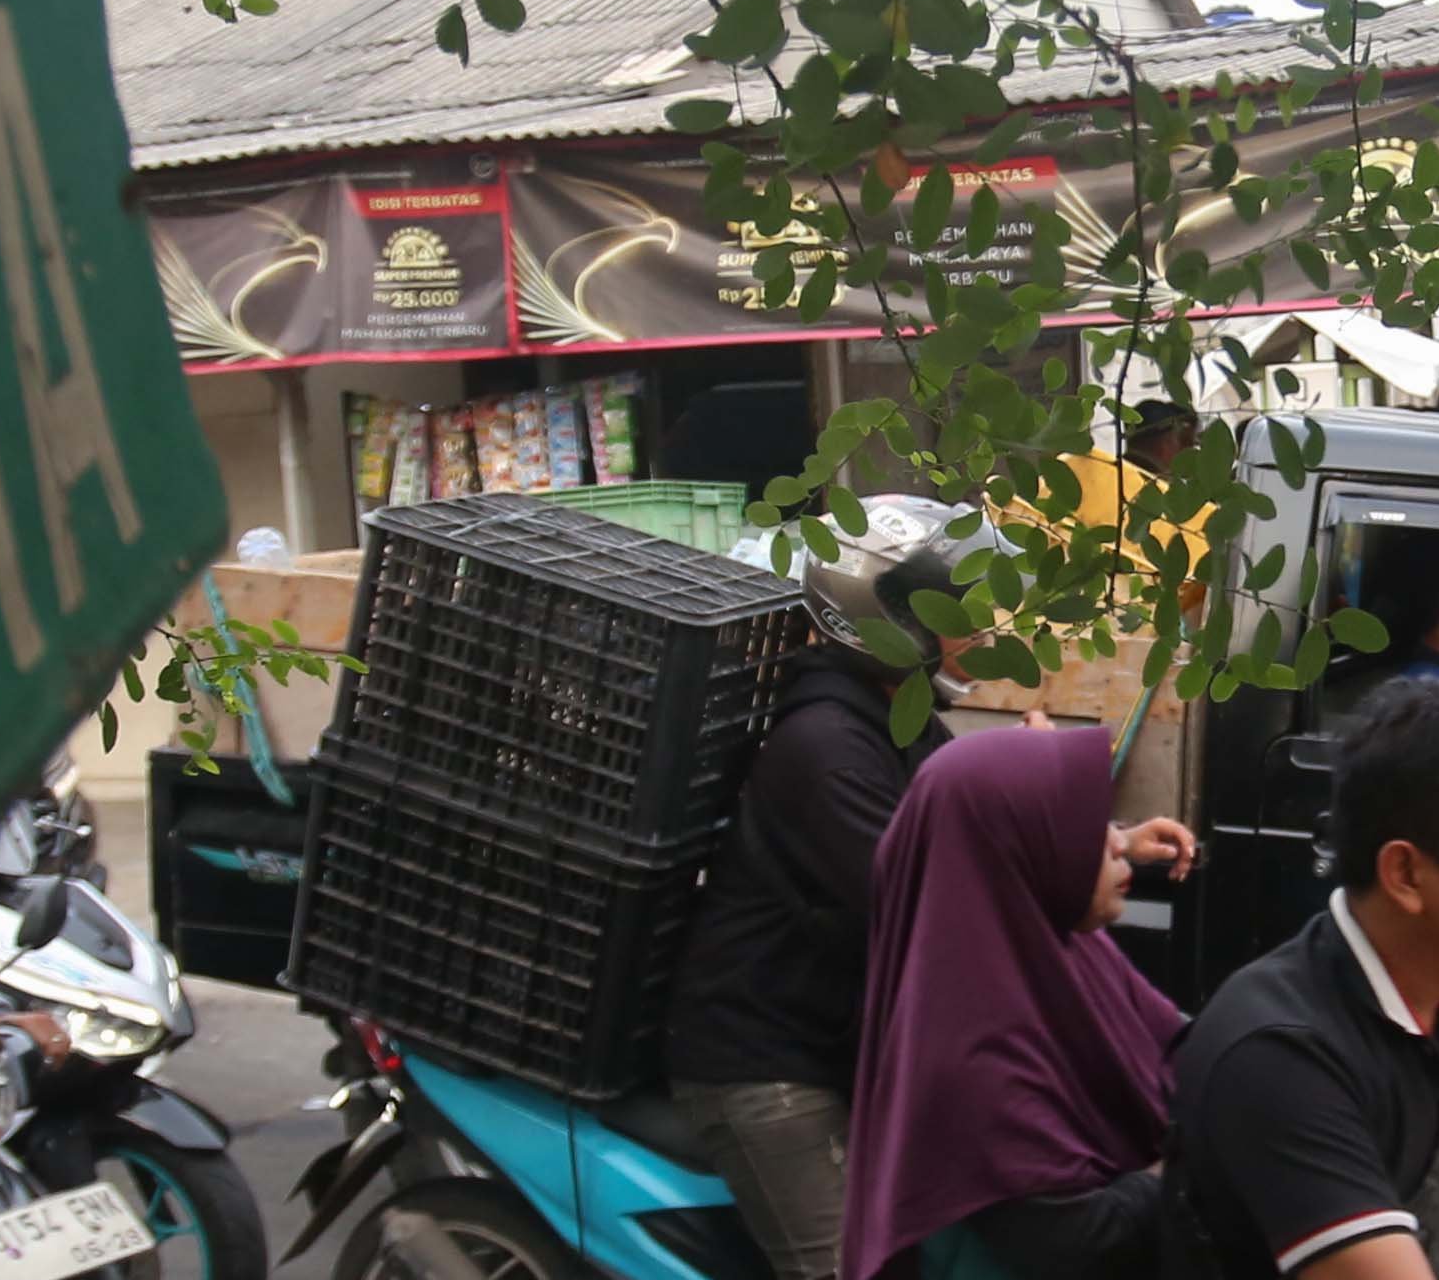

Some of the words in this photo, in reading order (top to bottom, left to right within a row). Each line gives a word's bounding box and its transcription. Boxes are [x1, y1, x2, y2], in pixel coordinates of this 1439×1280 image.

[951, 166, 1035, 187] ERBATAS
[369, 194, 401, 211] EDISI
[404, 192, 483, 209] TERBATAS
[718, 287, 740, 304] Rp
[366, 312, 465, 325] PERSEMBAHAN
[340, 327, 427, 340] MAHAKARYA
[429, 324, 487, 338] TERBARU
